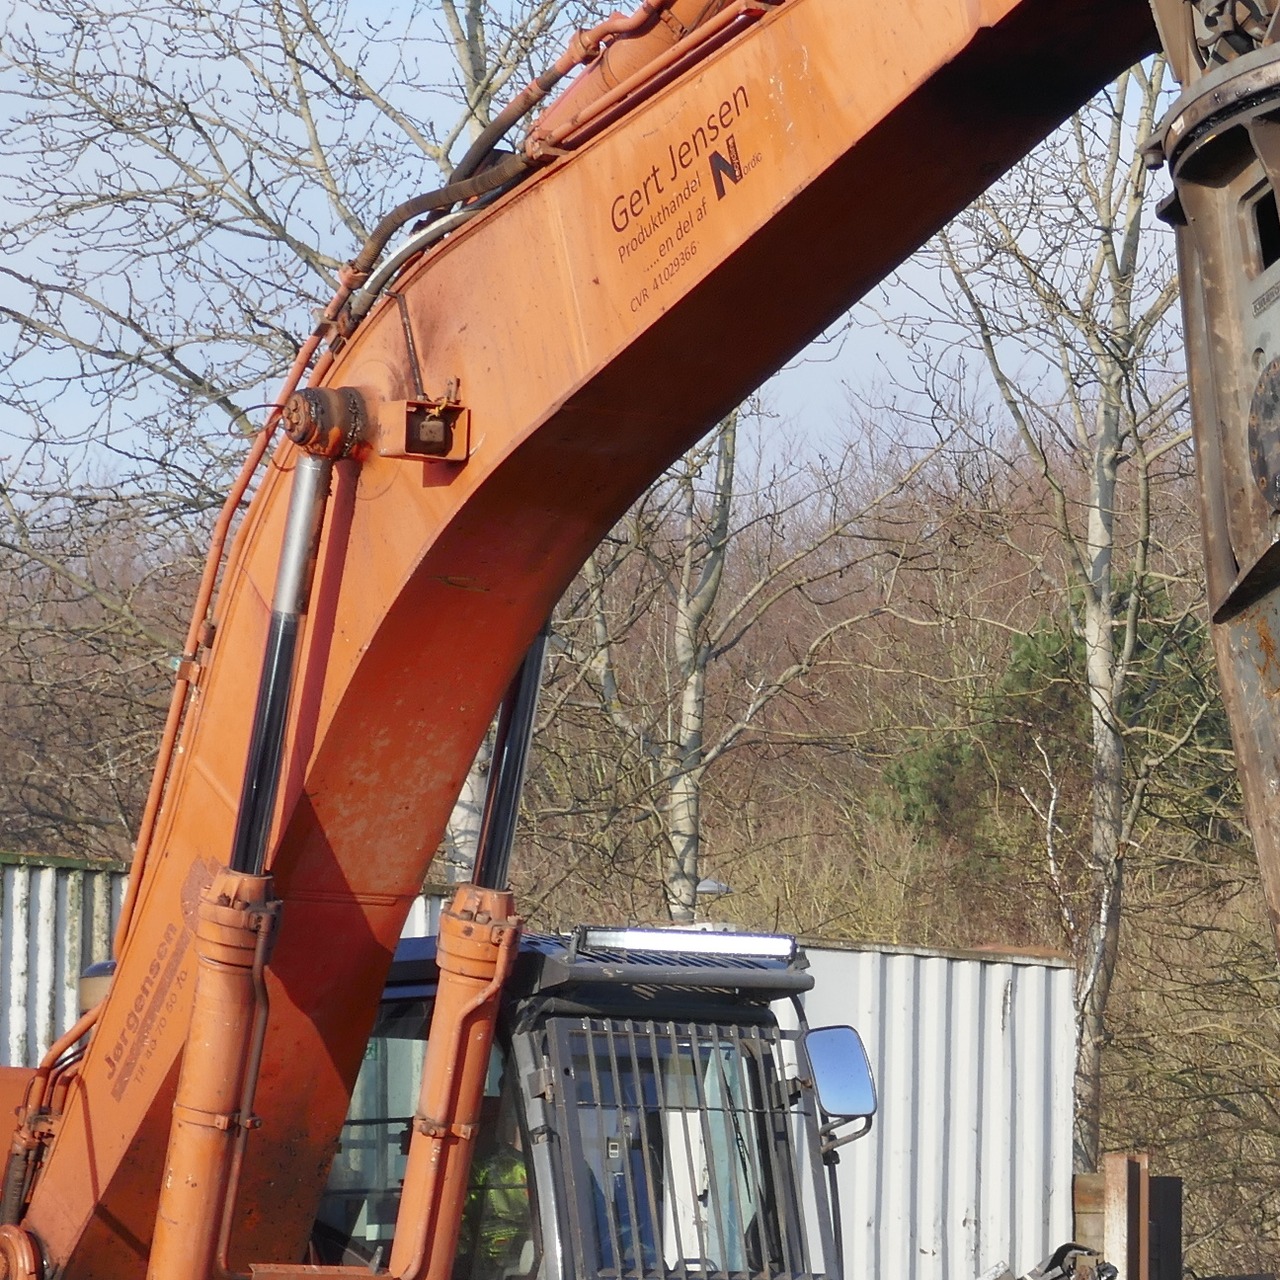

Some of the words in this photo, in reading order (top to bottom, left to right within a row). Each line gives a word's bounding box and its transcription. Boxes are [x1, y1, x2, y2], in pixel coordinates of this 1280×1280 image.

[611, 164, 664, 232] Gert
[668, 85, 749, 181] Jensen
[618, 170, 702, 263] Produkthandel
[675, 211, 694, 240] del
[696, 196, 707, 221] af
[630, 287, 650, 313] CVR
[653, 241, 697, 292] 41029366
